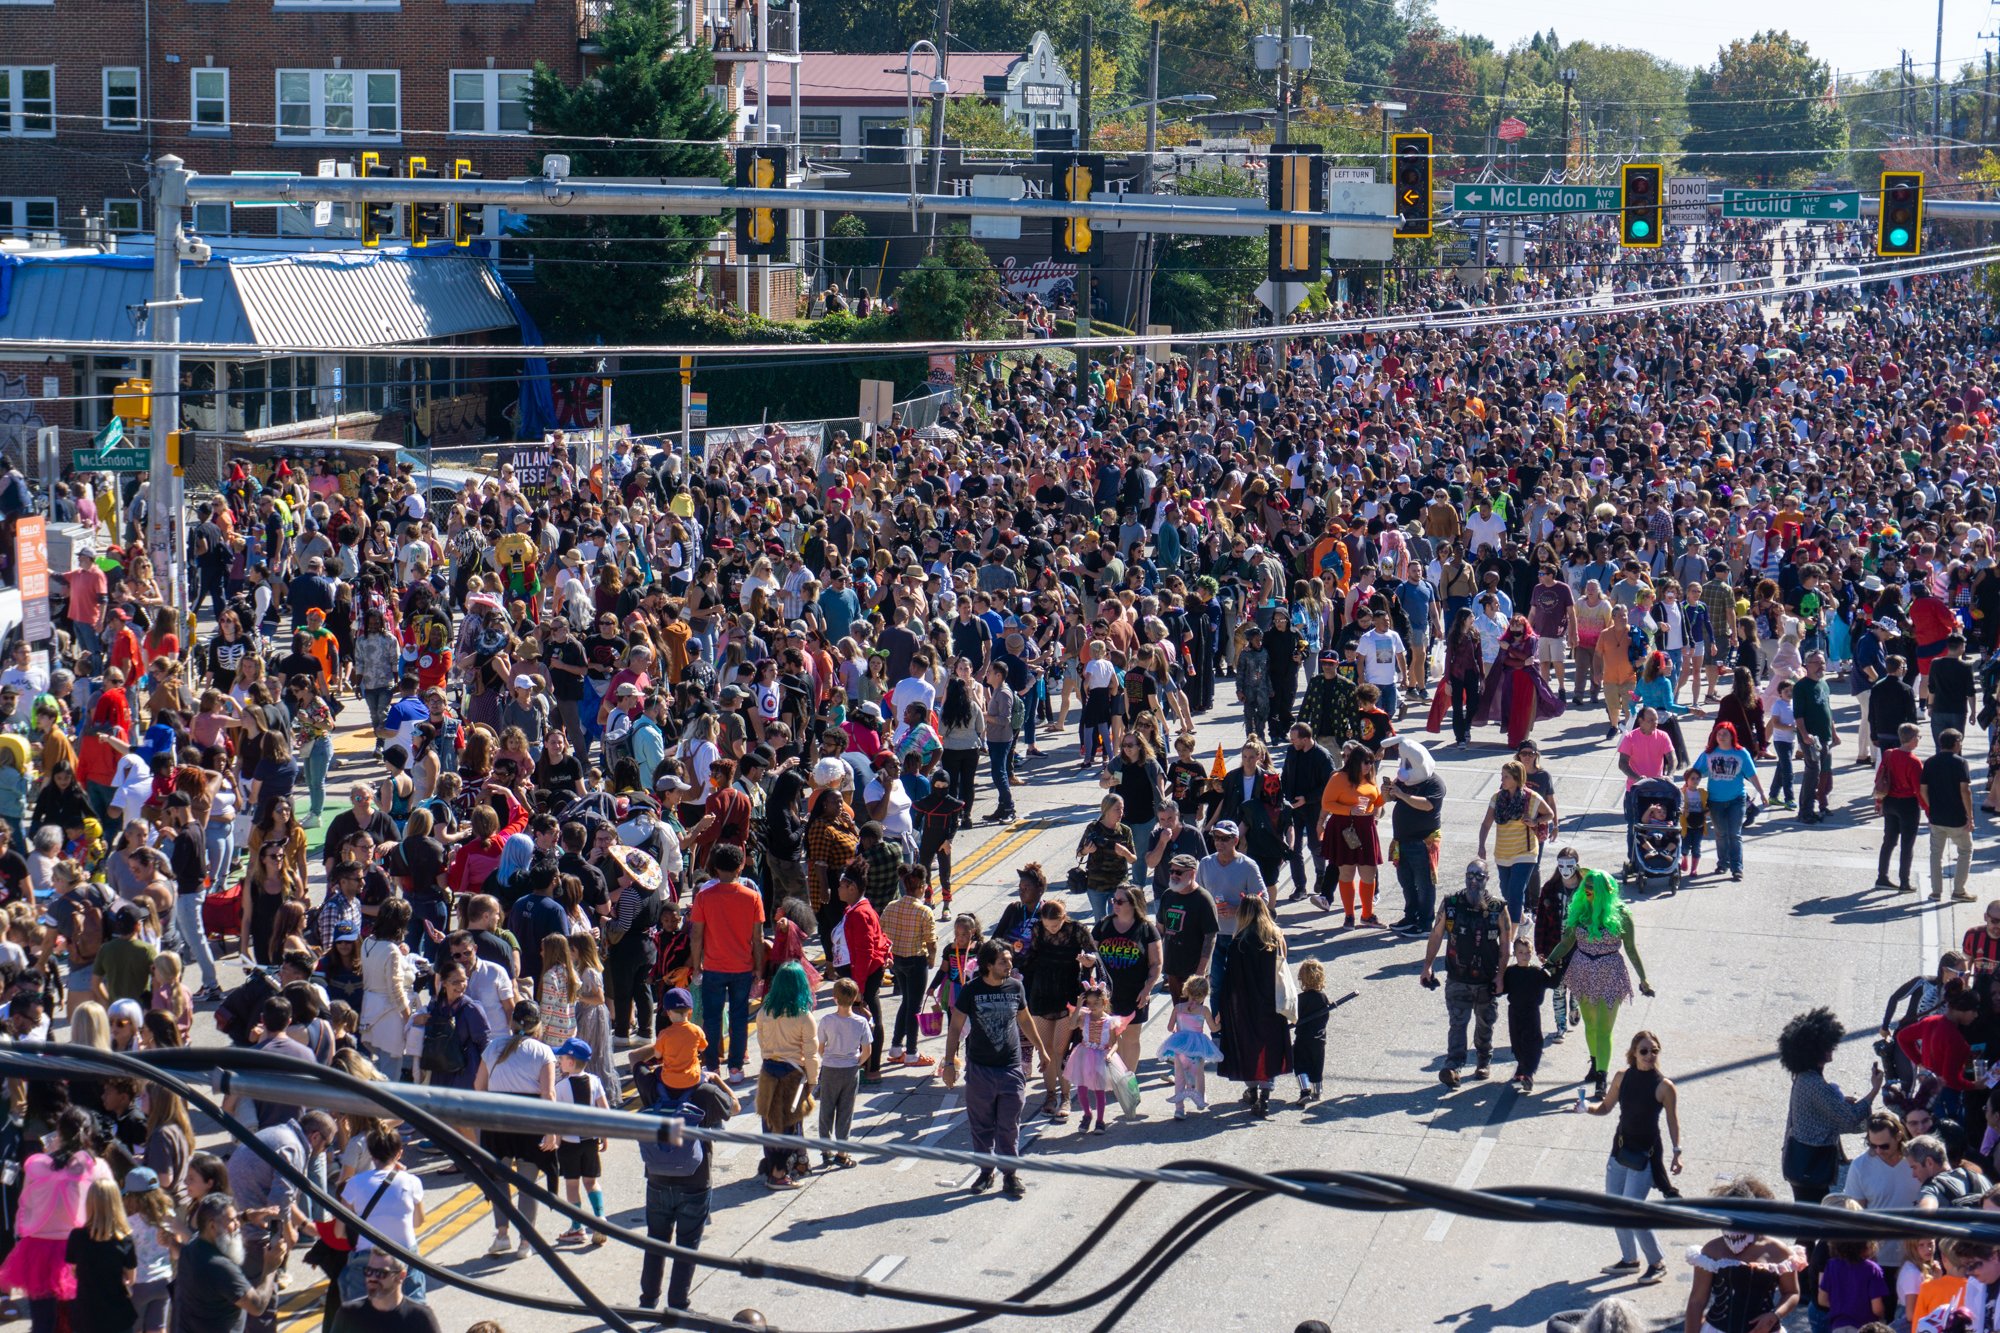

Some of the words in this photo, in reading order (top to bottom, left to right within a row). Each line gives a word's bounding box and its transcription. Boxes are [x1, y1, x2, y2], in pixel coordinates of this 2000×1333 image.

[1352, 171, 1370, 179] TURN
[1672, 184, 1685, 195] DO
[1686, 184, 1705, 195] NOT
[1490, 187, 1587, 208] McLendon
[1595, 188, 1615, 199] Ave
[1733, 192, 1791, 213] Euclid
[1597, 199, 1611, 209] NE
[1671, 200, 1706, 210] BLOCK
[1802, 204, 1817, 215] NE
[1670, 213, 1706, 221] INTERSECTION
[80, 454, 134, 468] McLendon
[1099, 944, 1140, 959] QUEER
[975, 994, 988, 1002] NEW
